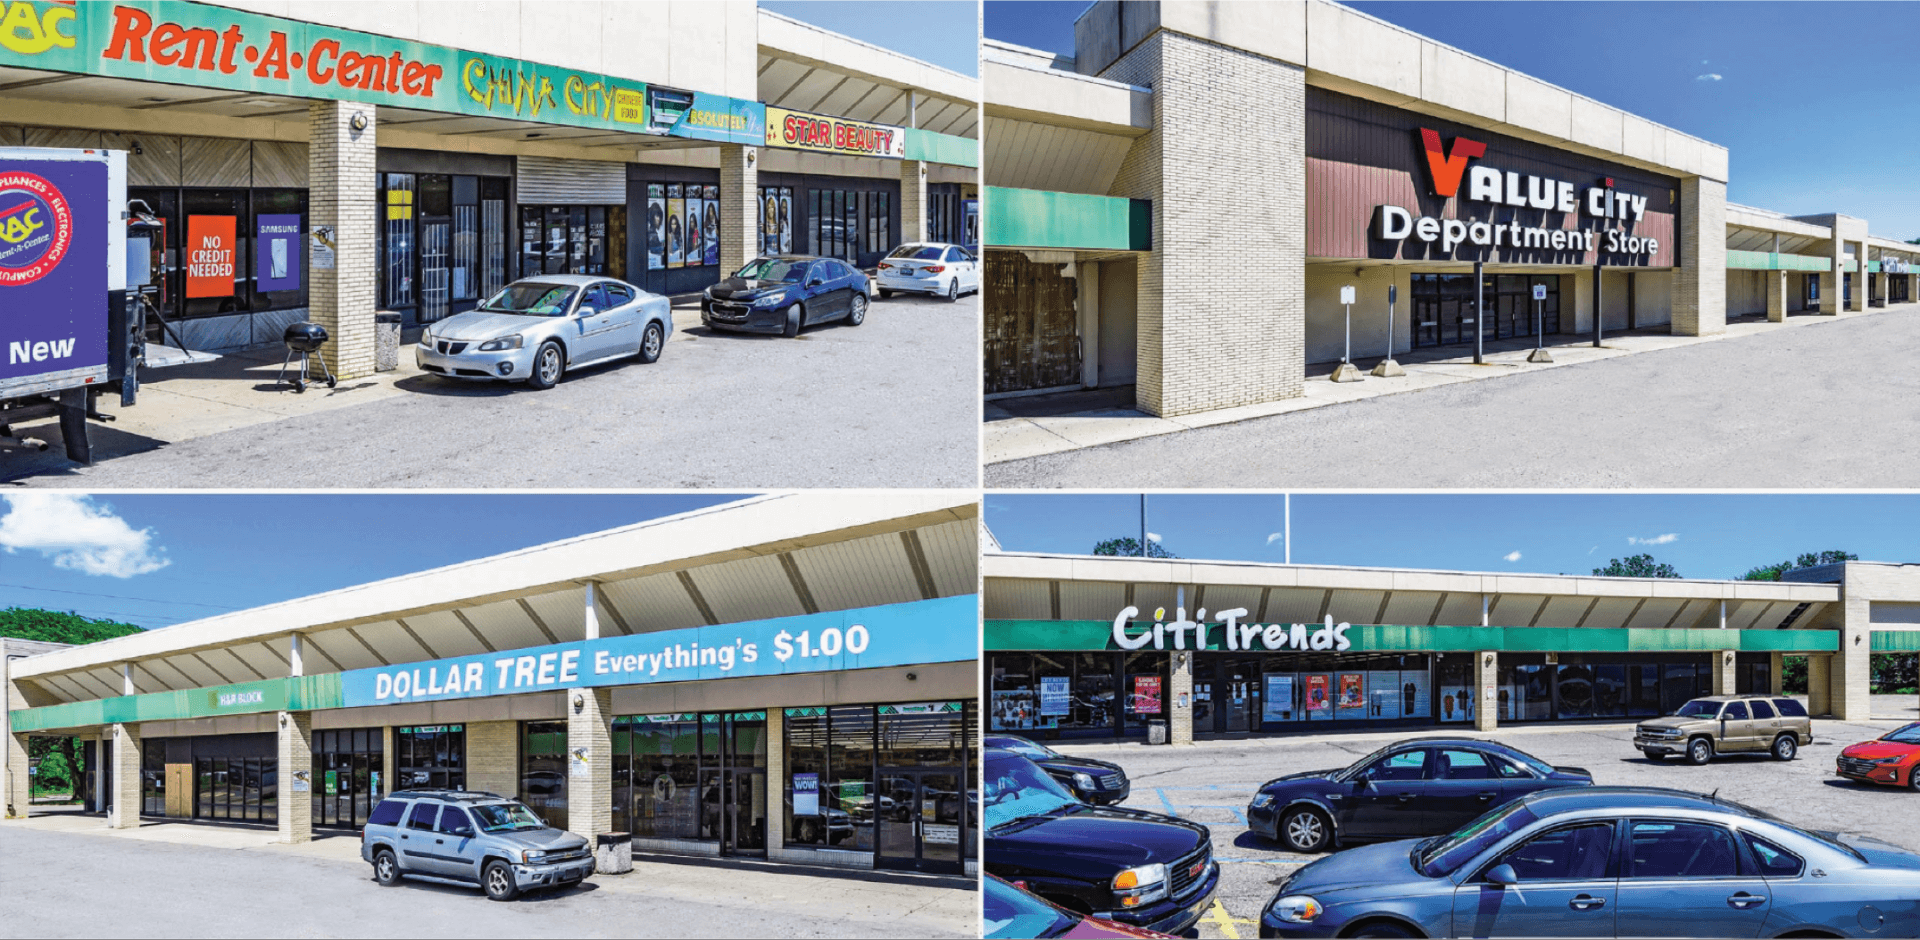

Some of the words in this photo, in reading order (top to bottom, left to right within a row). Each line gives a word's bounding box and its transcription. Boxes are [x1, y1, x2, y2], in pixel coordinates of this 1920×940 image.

[621, 107, 638, 119] FOOD
[784, 114, 832, 148] STAR
[834, 122, 893, 154] BEAUTY
[49, 198, 69, 261] ELECTRONICS
[260, 225, 298, 234] SAMSUNG
[1377, 205, 1593, 252] Department
[1607, 228, 1659, 255] Store
[203, 235, 221, 249] NO
[192, 249, 231, 263] CREDIT
[189, 263, 233, 278] NEEDED
[9, 337, 76, 365] New
[1113, 606, 1206, 650] Citi
[1215, 607, 1351, 651] Trends
[376, 662, 484, 700] DOLLAR
[495, 649, 580, 689] TREE
[594, 637, 759, 676] Everything's
[774, 624, 870, 663] $1.00
[1047, 683, 1064, 692] NOW
[237, 691, 262, 703] BLOCK
